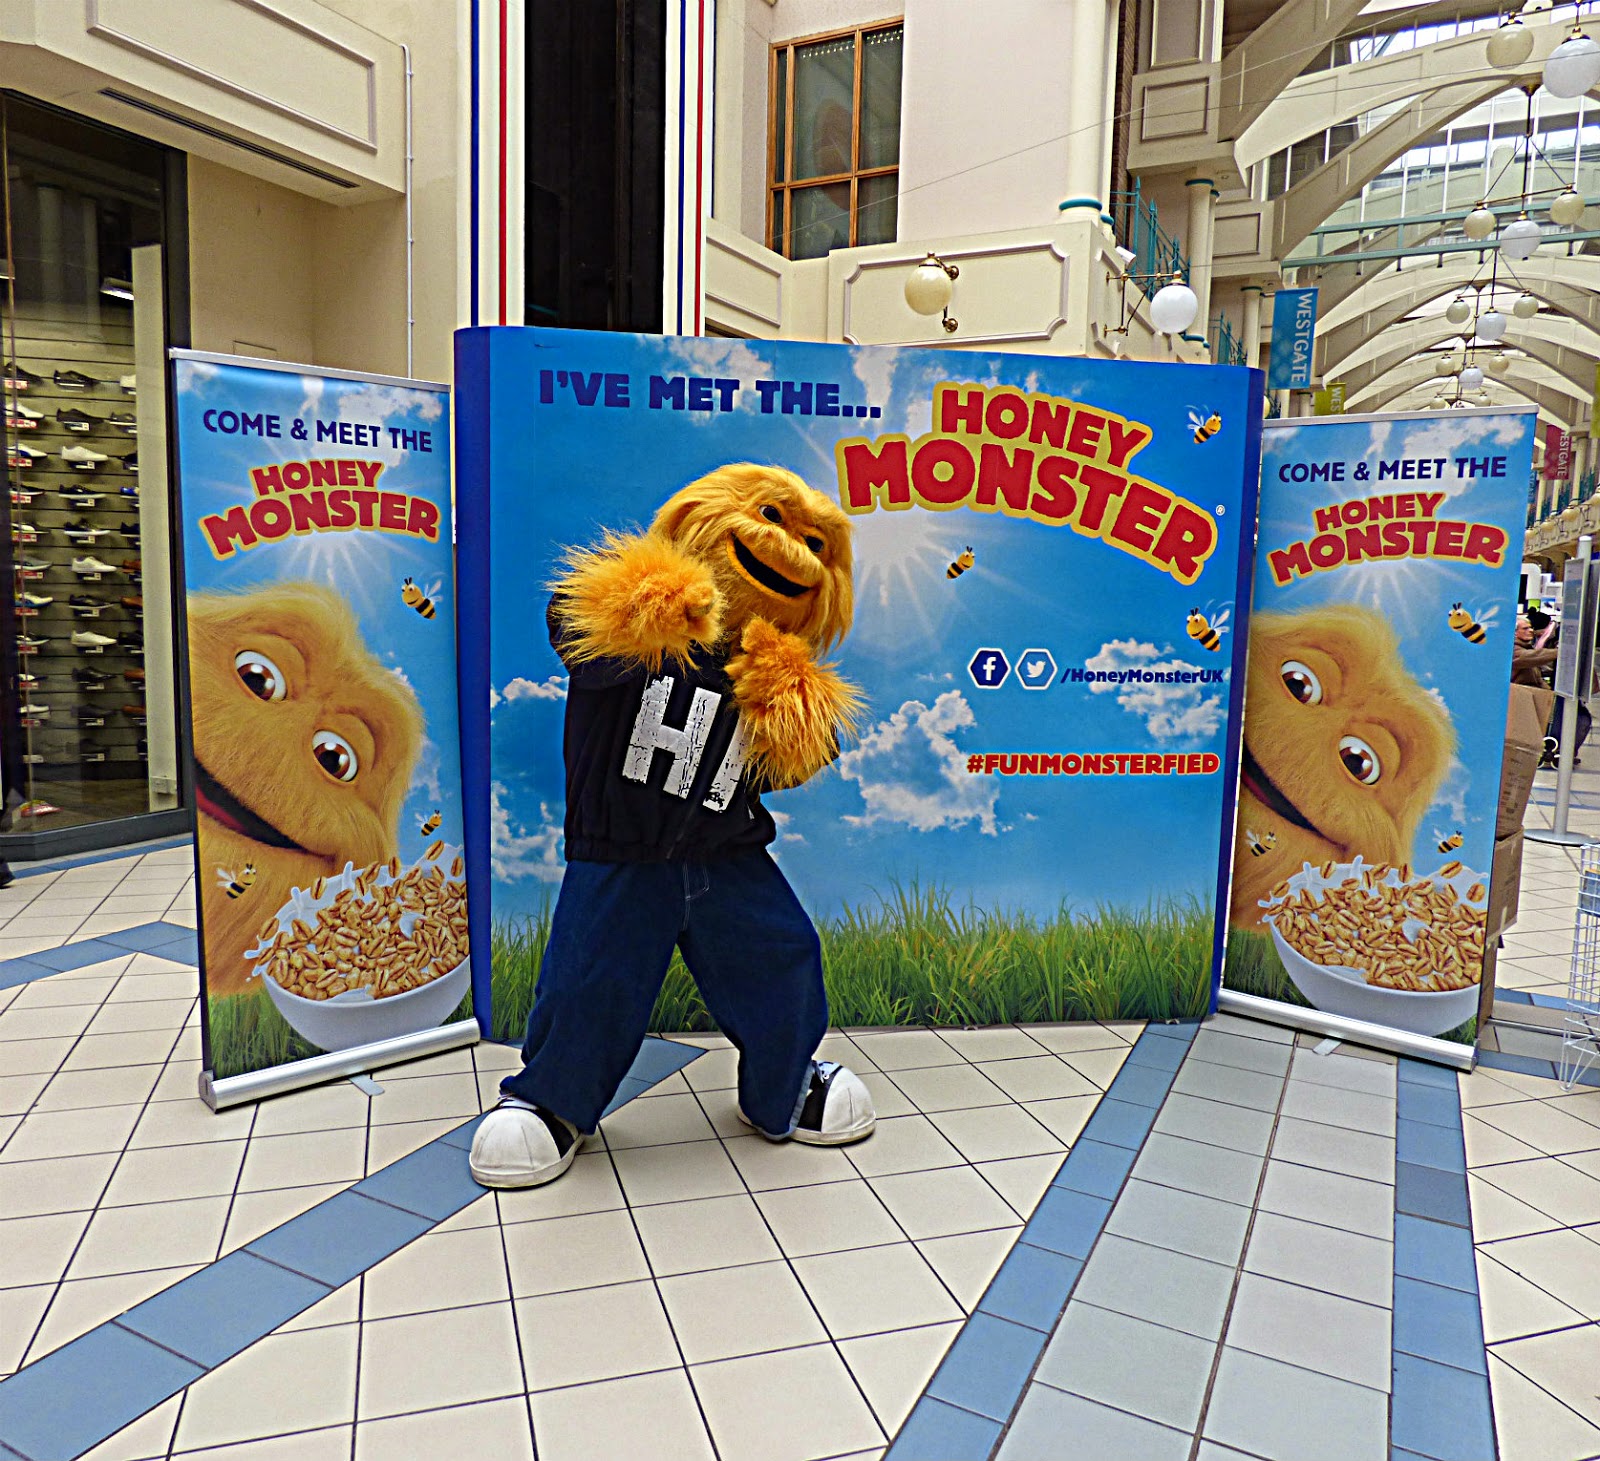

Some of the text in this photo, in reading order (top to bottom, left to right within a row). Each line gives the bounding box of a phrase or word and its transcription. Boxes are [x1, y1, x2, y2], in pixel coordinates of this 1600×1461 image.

[1291, 292, 1314, 383] WESTGATE
[540, 370, 882, 418] I'VE MET THE...
[203, 409, 433, 453] COME & MEET THE
[940, 388, 1148, 469] HONEY
[1278, 456, 1507, 483] COME & MEET THE
[1556, 431, 1570, 477] ESTGATE
[251, 459, 383, 497] HONEY
[202, 489, 440, 557] MONSTER
[842, 437, 1214, 580] MONSTER
[1314, 492, 1446, 532] HONEY
[1269, 520, 1506, 584] MONSTER
[967, 753, 1220, 776] #FUNMONSTERFIED
